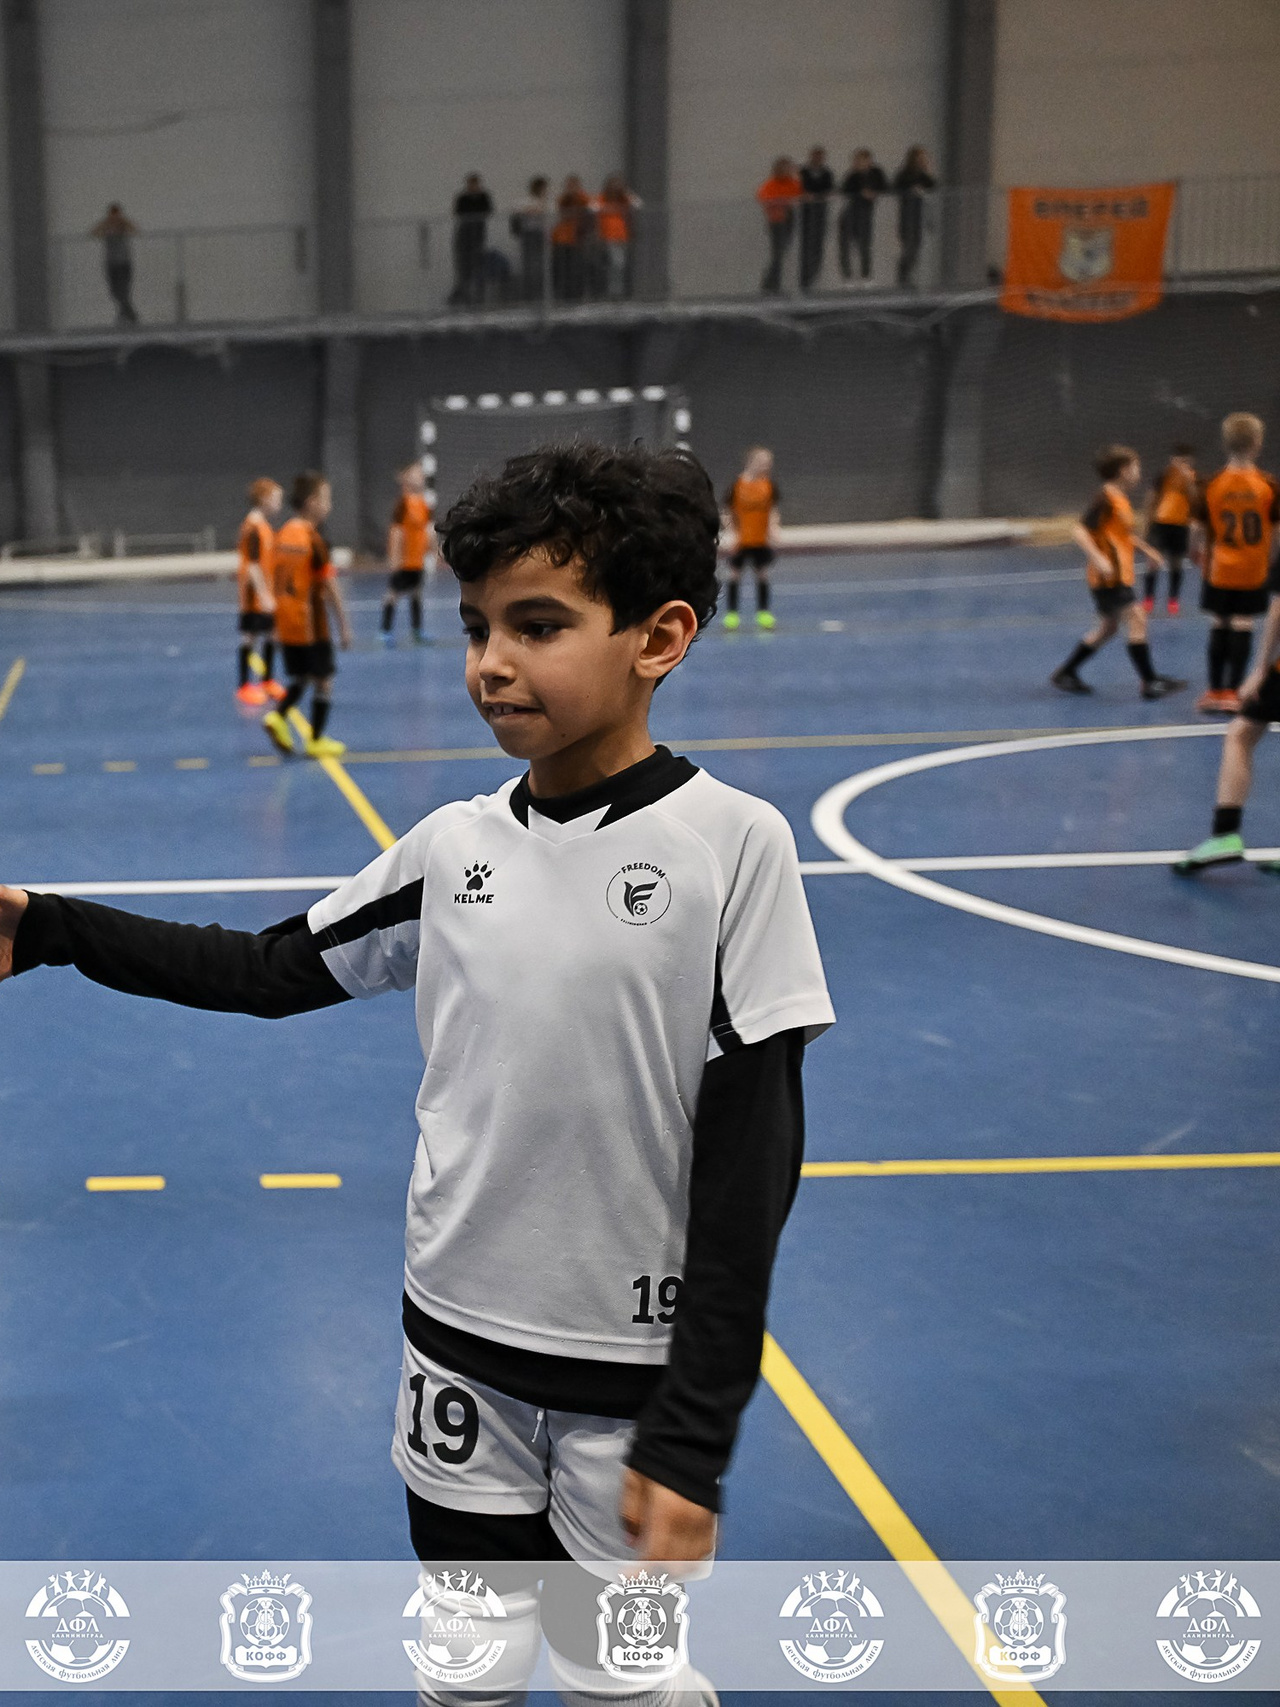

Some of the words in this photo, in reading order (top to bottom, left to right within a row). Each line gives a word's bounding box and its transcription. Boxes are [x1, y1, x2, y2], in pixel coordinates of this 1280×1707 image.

[1221, 509, 1264, 547] 20
[621, 862, 666, 879] FREEDOM
[453, 893, 495, 904] KELME
[631, 1275, 685, 1325] 19
[407, 1372, 480, 1465] 19
